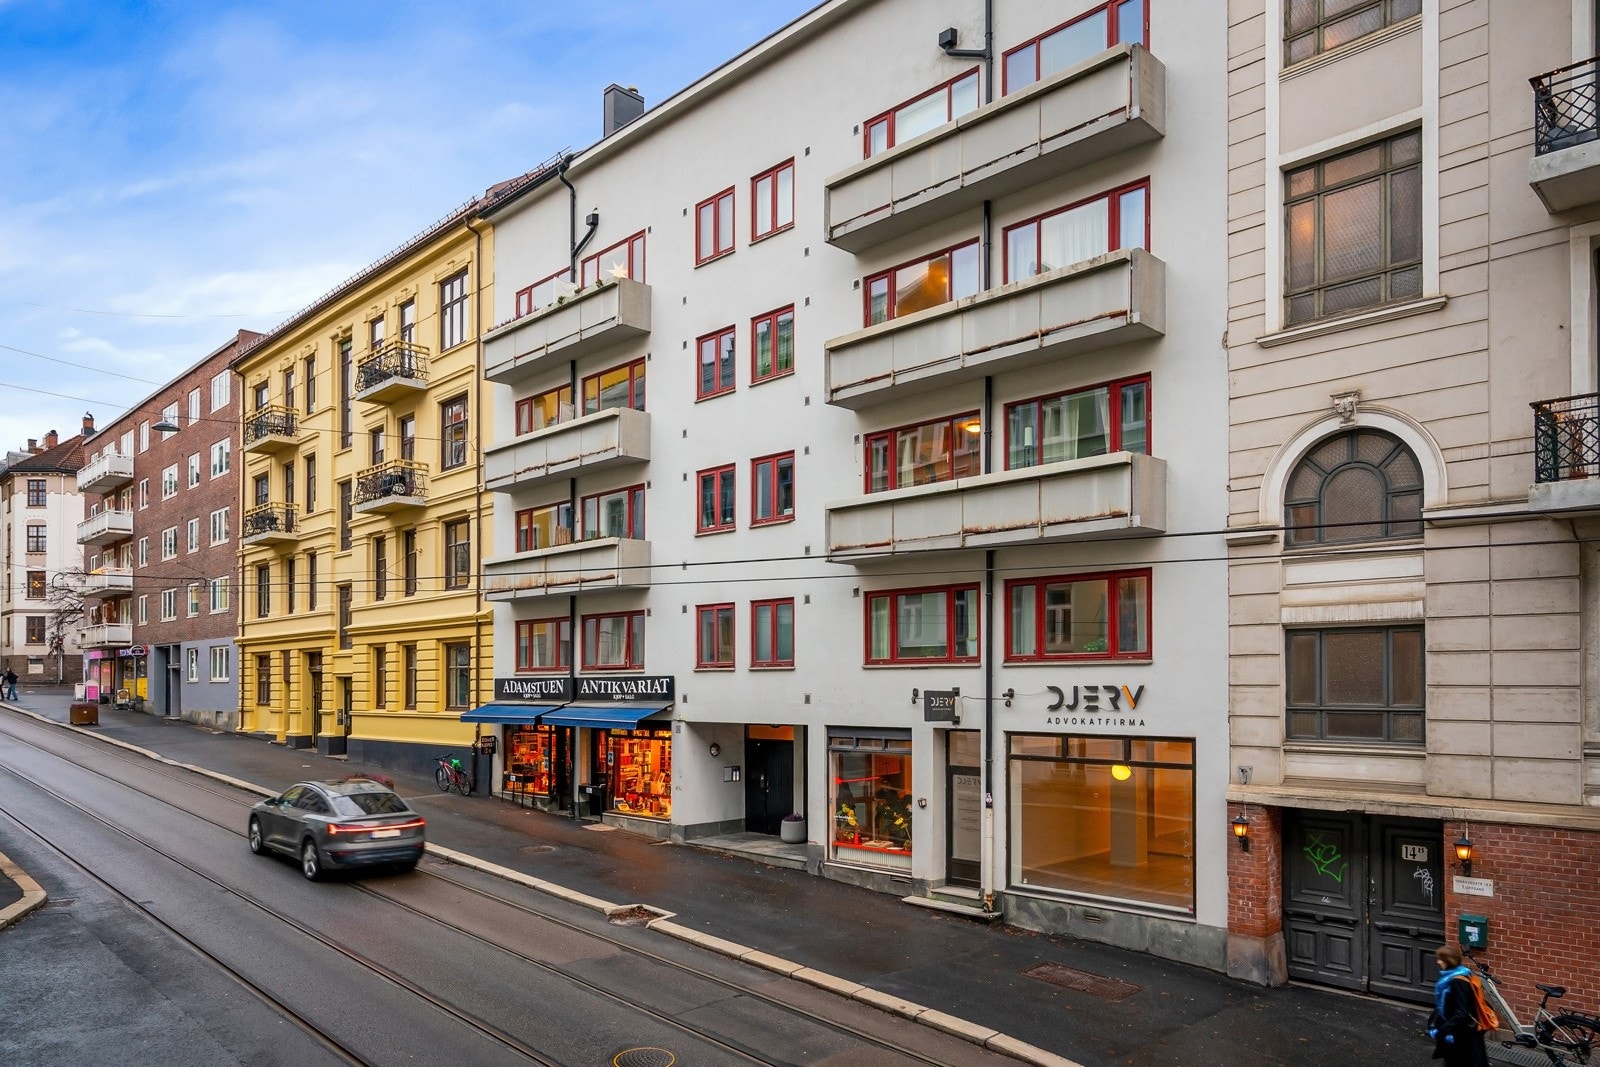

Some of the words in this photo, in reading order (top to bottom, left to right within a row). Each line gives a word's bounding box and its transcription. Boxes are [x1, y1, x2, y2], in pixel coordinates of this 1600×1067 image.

[503, 679, 564, 694] ADAMSTUEN
[580, 678, 670, 694] ANTIKVARIAT
[930, 697, 954, 707] DJERV
[1046, 684, 1145, 711] DJERV
[1046, 717, 1146, 727] ADVOKATFIRMA
